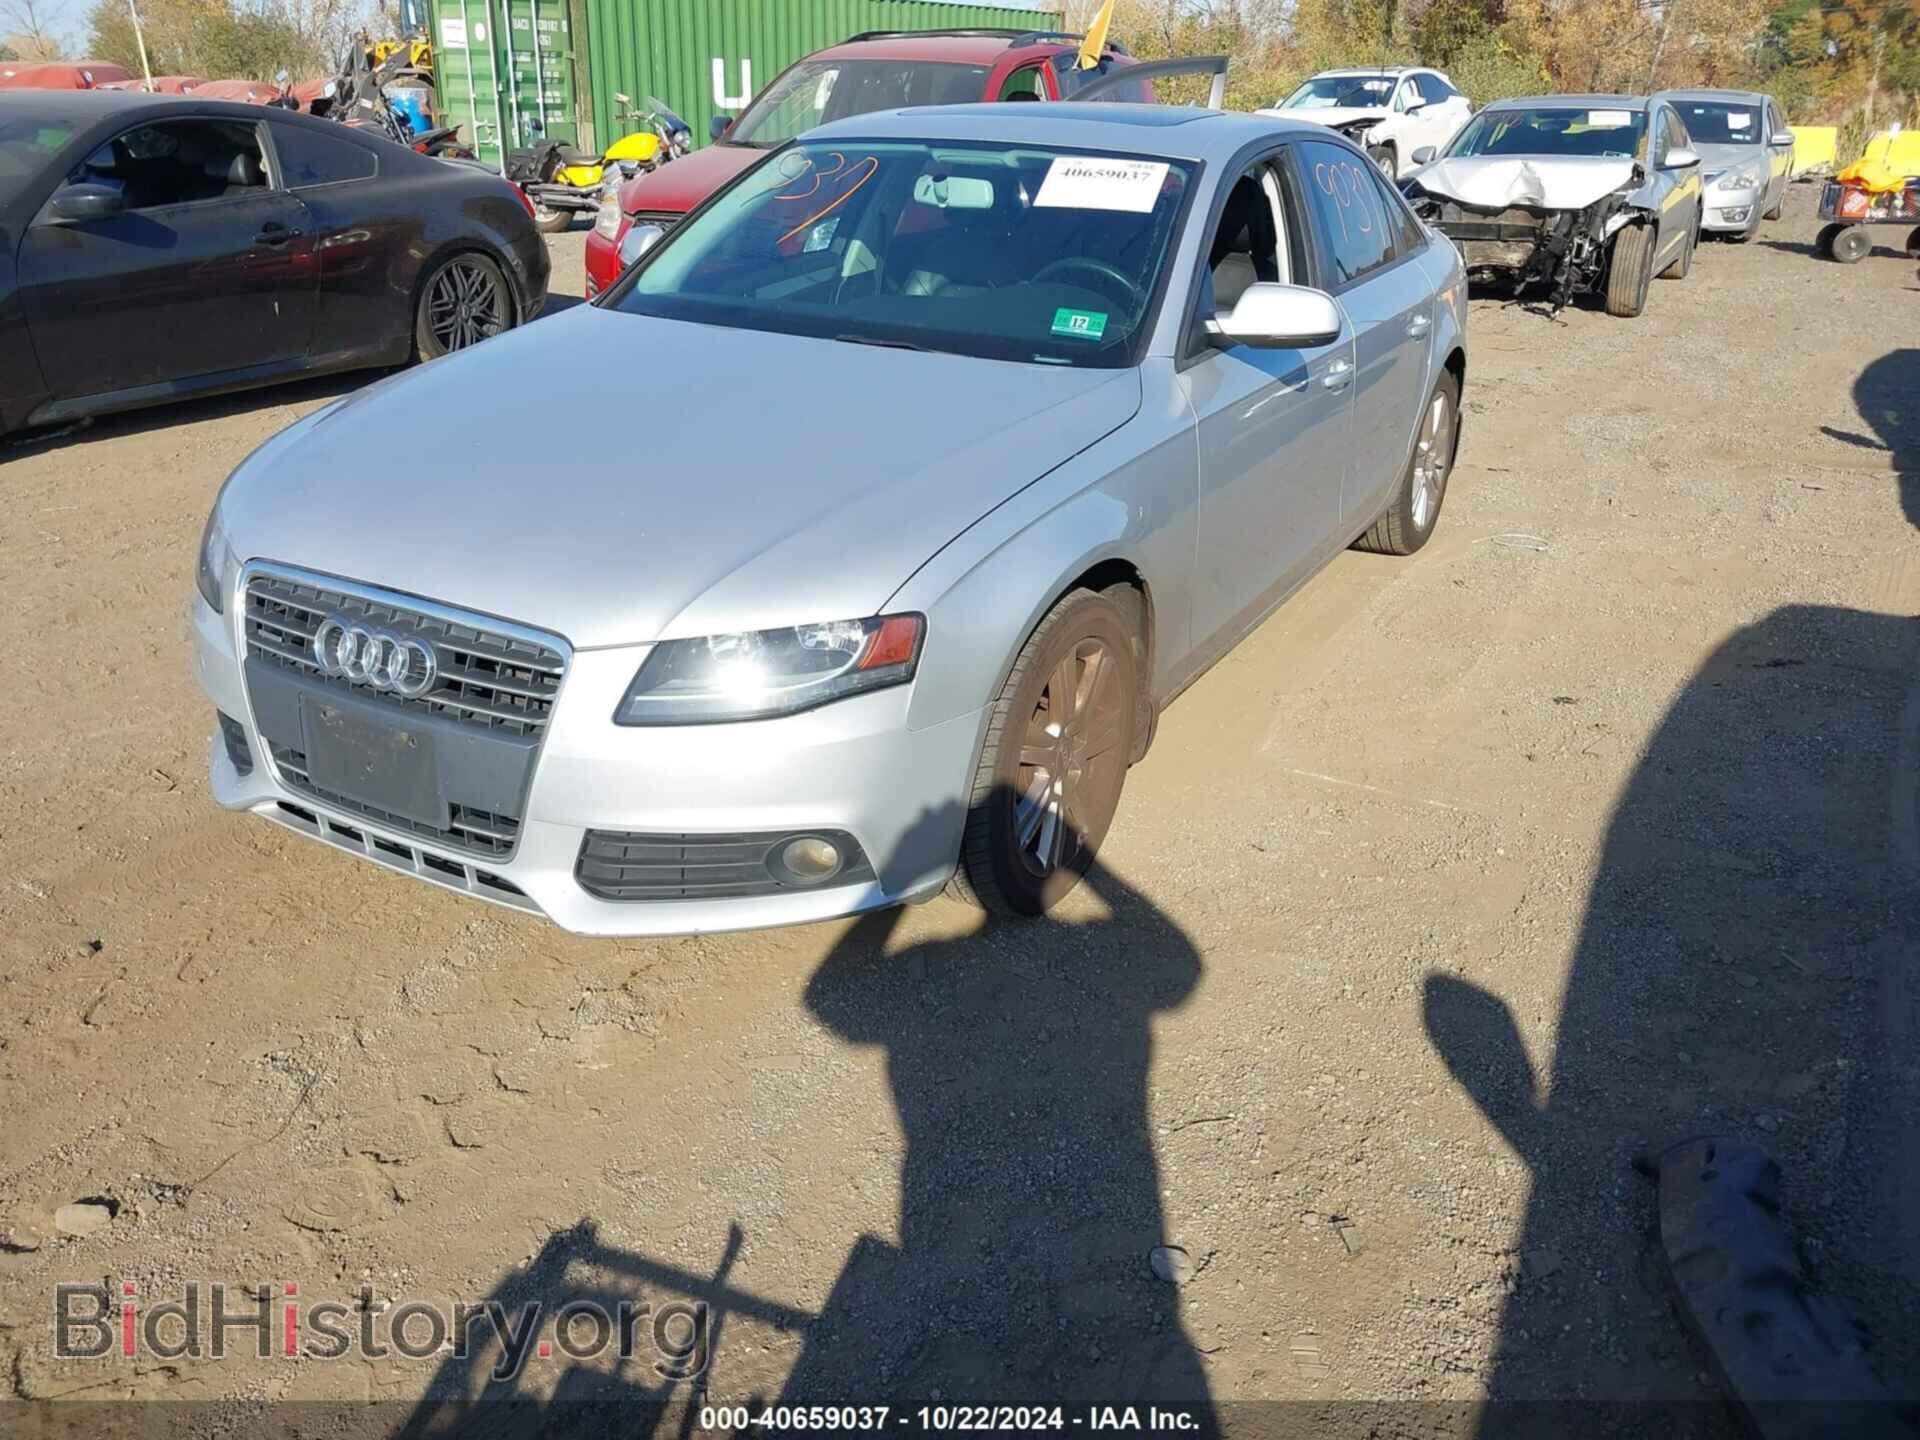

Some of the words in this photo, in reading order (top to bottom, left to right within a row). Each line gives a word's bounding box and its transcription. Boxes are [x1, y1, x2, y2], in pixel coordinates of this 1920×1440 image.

[712, 58, 752, 109] U
[1059, 167, 1152, 181] 40659037
[1072, 317, 1087, 328] 12
